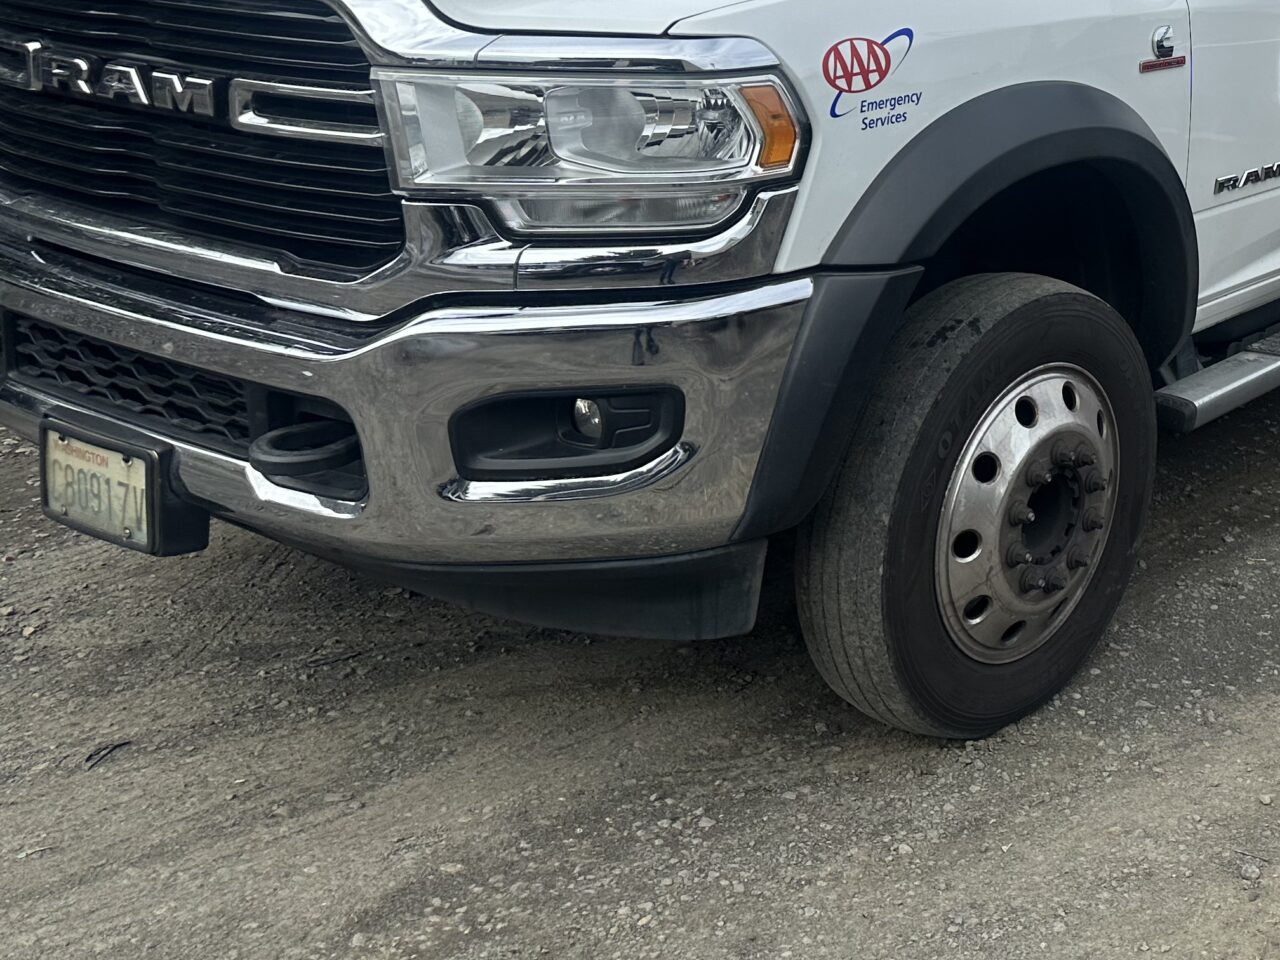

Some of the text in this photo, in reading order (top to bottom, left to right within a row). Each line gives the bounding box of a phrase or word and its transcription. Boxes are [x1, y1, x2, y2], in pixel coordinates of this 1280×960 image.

[825, 38, 889, 92] AAA
[50, 58, 214, 117] RAM
[860, 91, 922, 113] Emergency
[861, 112, 907, 131] Services
[53, 439, 109, 469] WASHINGTON
[52, 458, 145, 533] C80917V
